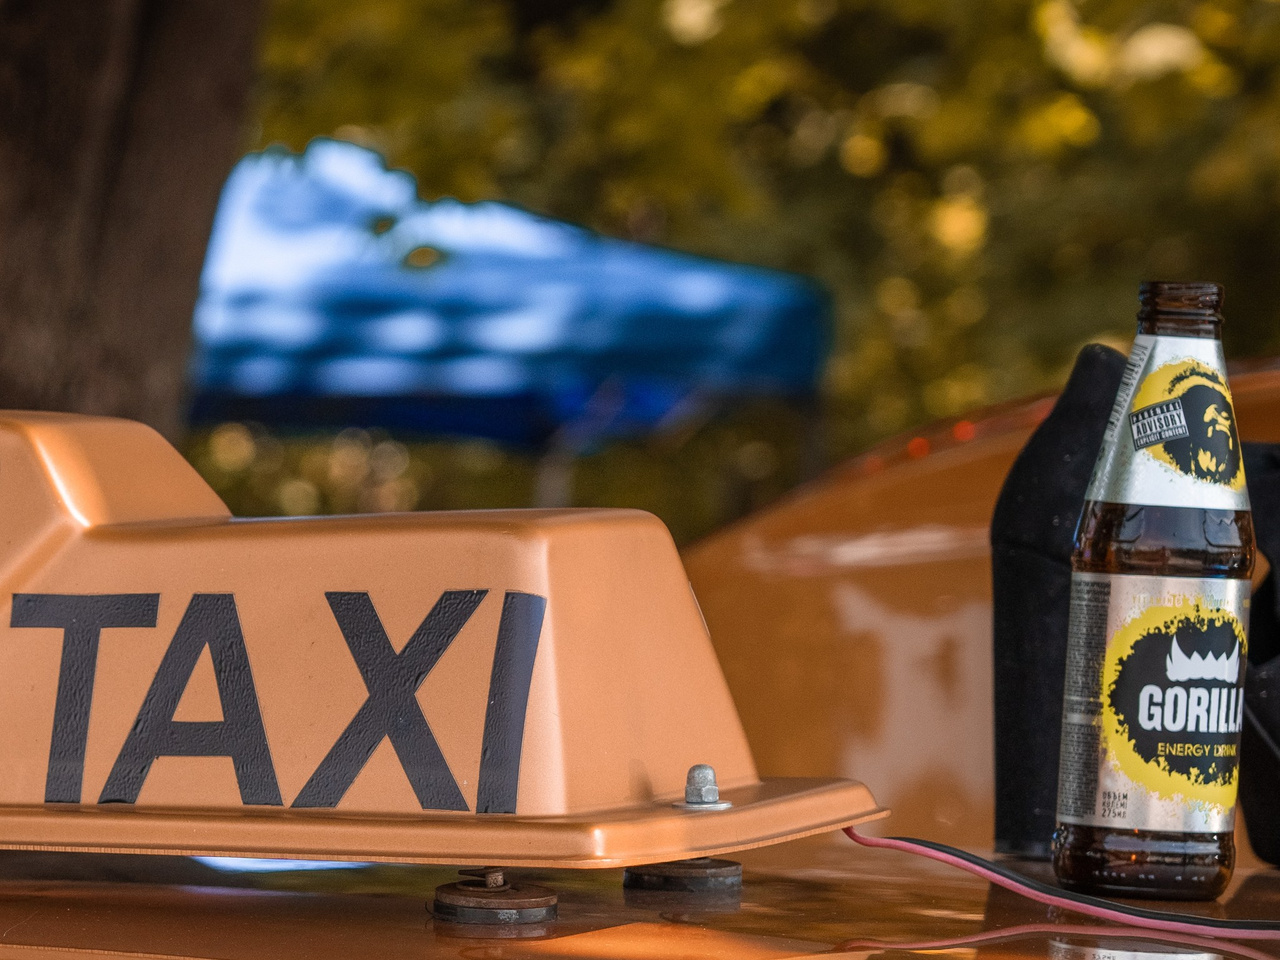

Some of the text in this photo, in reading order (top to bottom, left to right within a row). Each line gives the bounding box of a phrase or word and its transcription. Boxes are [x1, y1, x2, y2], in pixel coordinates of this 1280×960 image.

[1131, 401, 1182, 425] PARENTAL
[1135, 411, 1183, 437] ADVISORY
[1136, 424, 1188, 447] EXPLICIT CONTENT
[10, 588, 548, 814] TAXI
[1157, 742, 1238, 758] ENERGY DRINK
